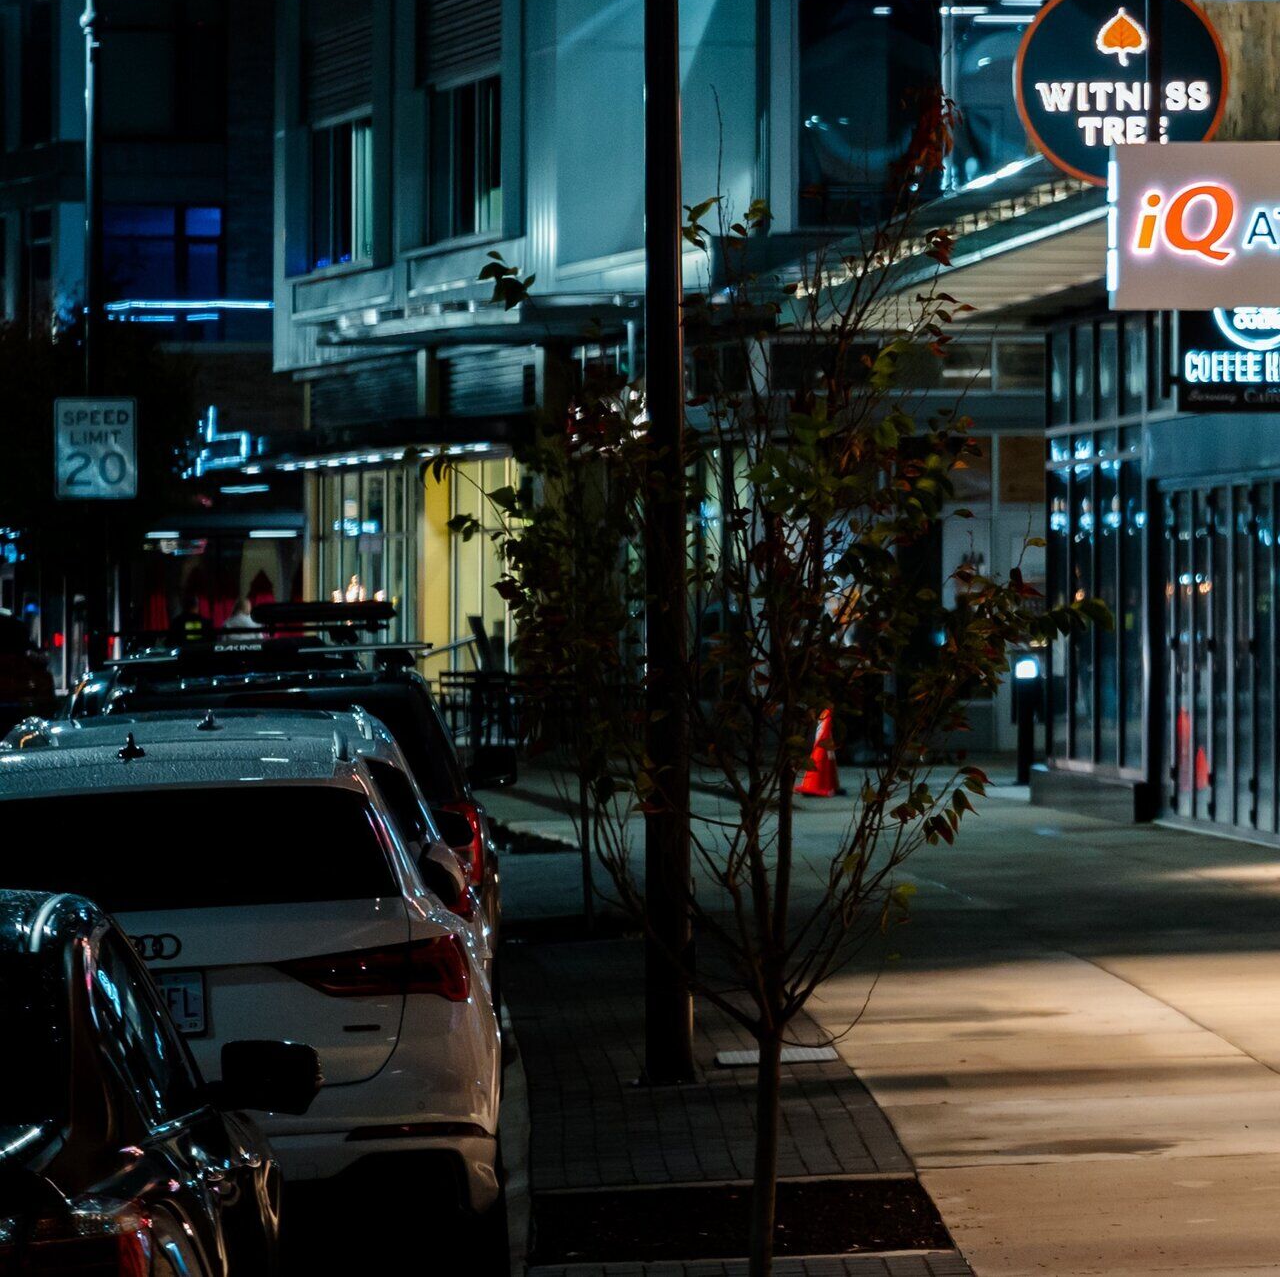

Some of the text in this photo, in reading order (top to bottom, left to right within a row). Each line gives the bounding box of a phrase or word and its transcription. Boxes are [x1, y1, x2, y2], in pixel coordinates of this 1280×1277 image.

[1035, 80, 1211, 112] WITNSS
[1134, 183, 1235, 264] iQ
[1185, 350, 1263, 383] COFFEE
[63, 409, 129, 425] SPEED
[70, 429, 121, 446] LIMIT
[65, 452, 127, 486] 20
